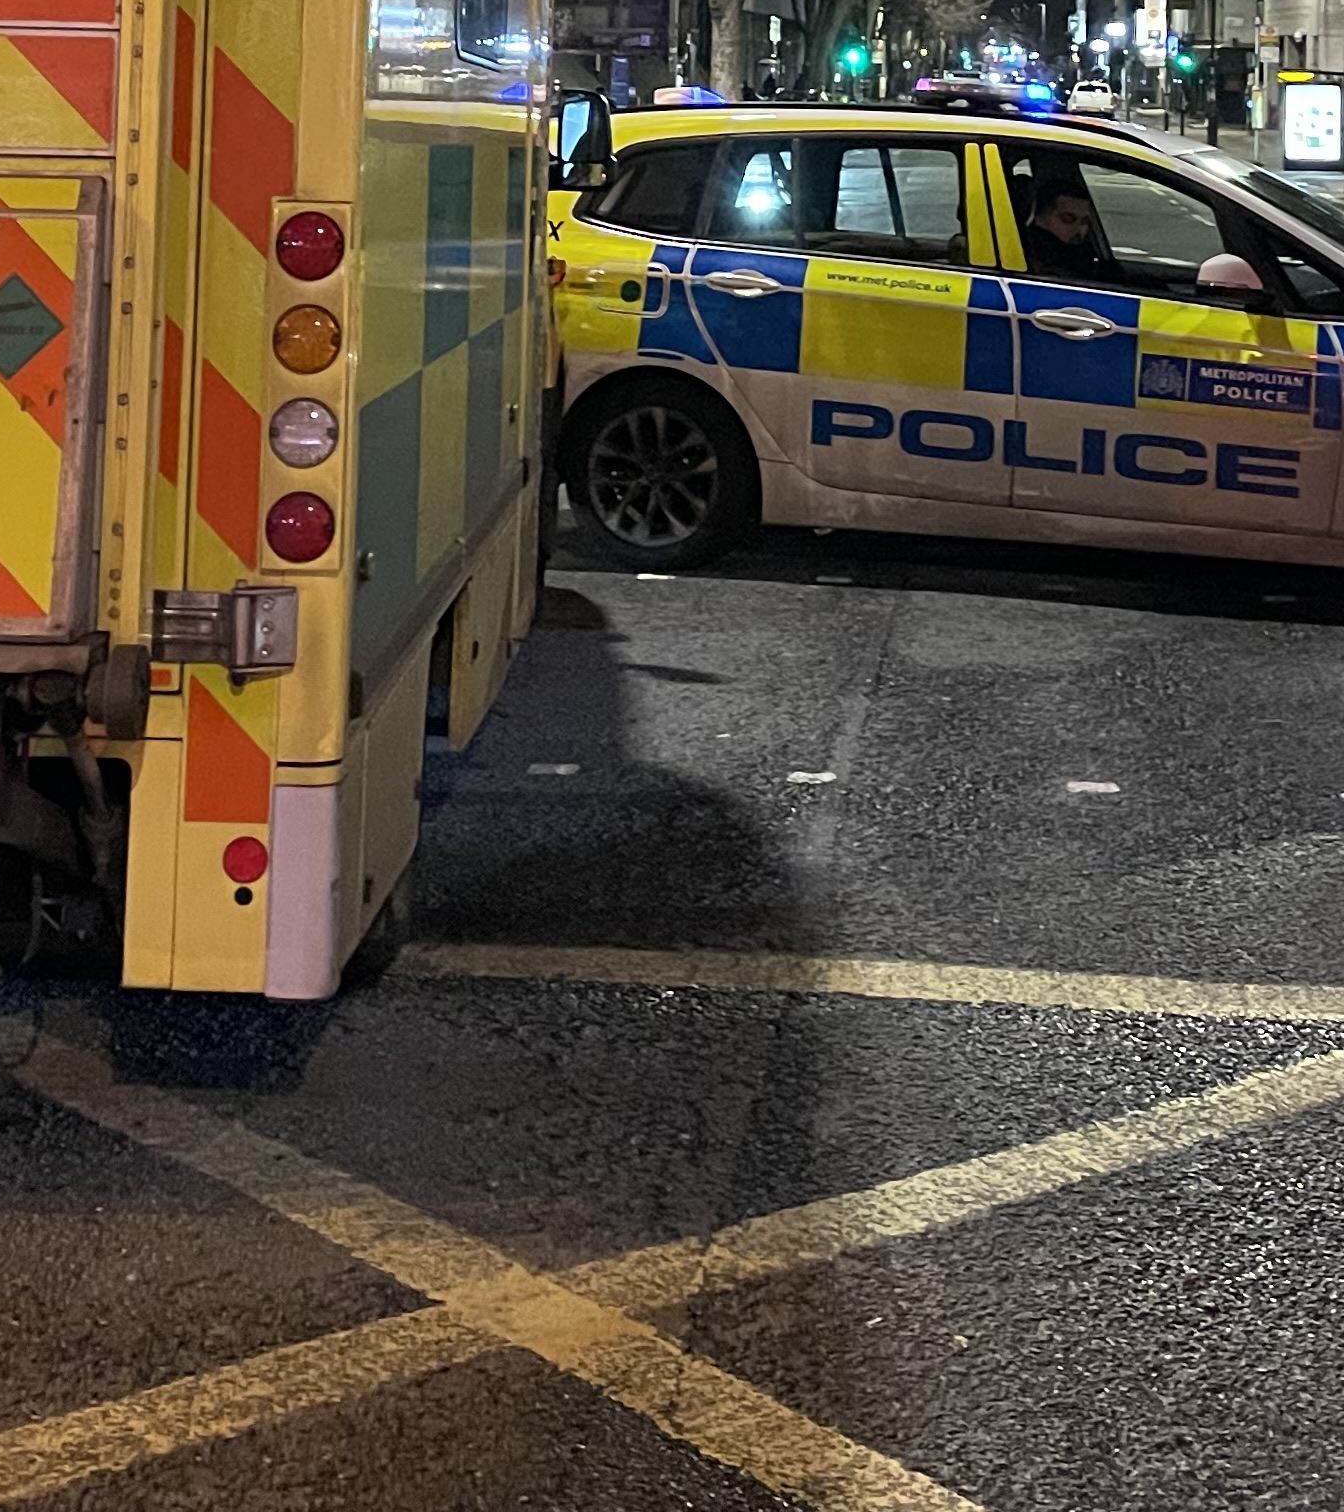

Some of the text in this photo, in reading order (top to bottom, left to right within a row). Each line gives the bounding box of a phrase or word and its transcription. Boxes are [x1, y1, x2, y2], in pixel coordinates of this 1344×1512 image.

[827, 273, 951, 293] www.met.police.uk
[1200, 367, 1304, 386] METROPOLITAN
[1214, 384, 1288, 404] POLICE
[810, 399, 1300, 498] POLICE
